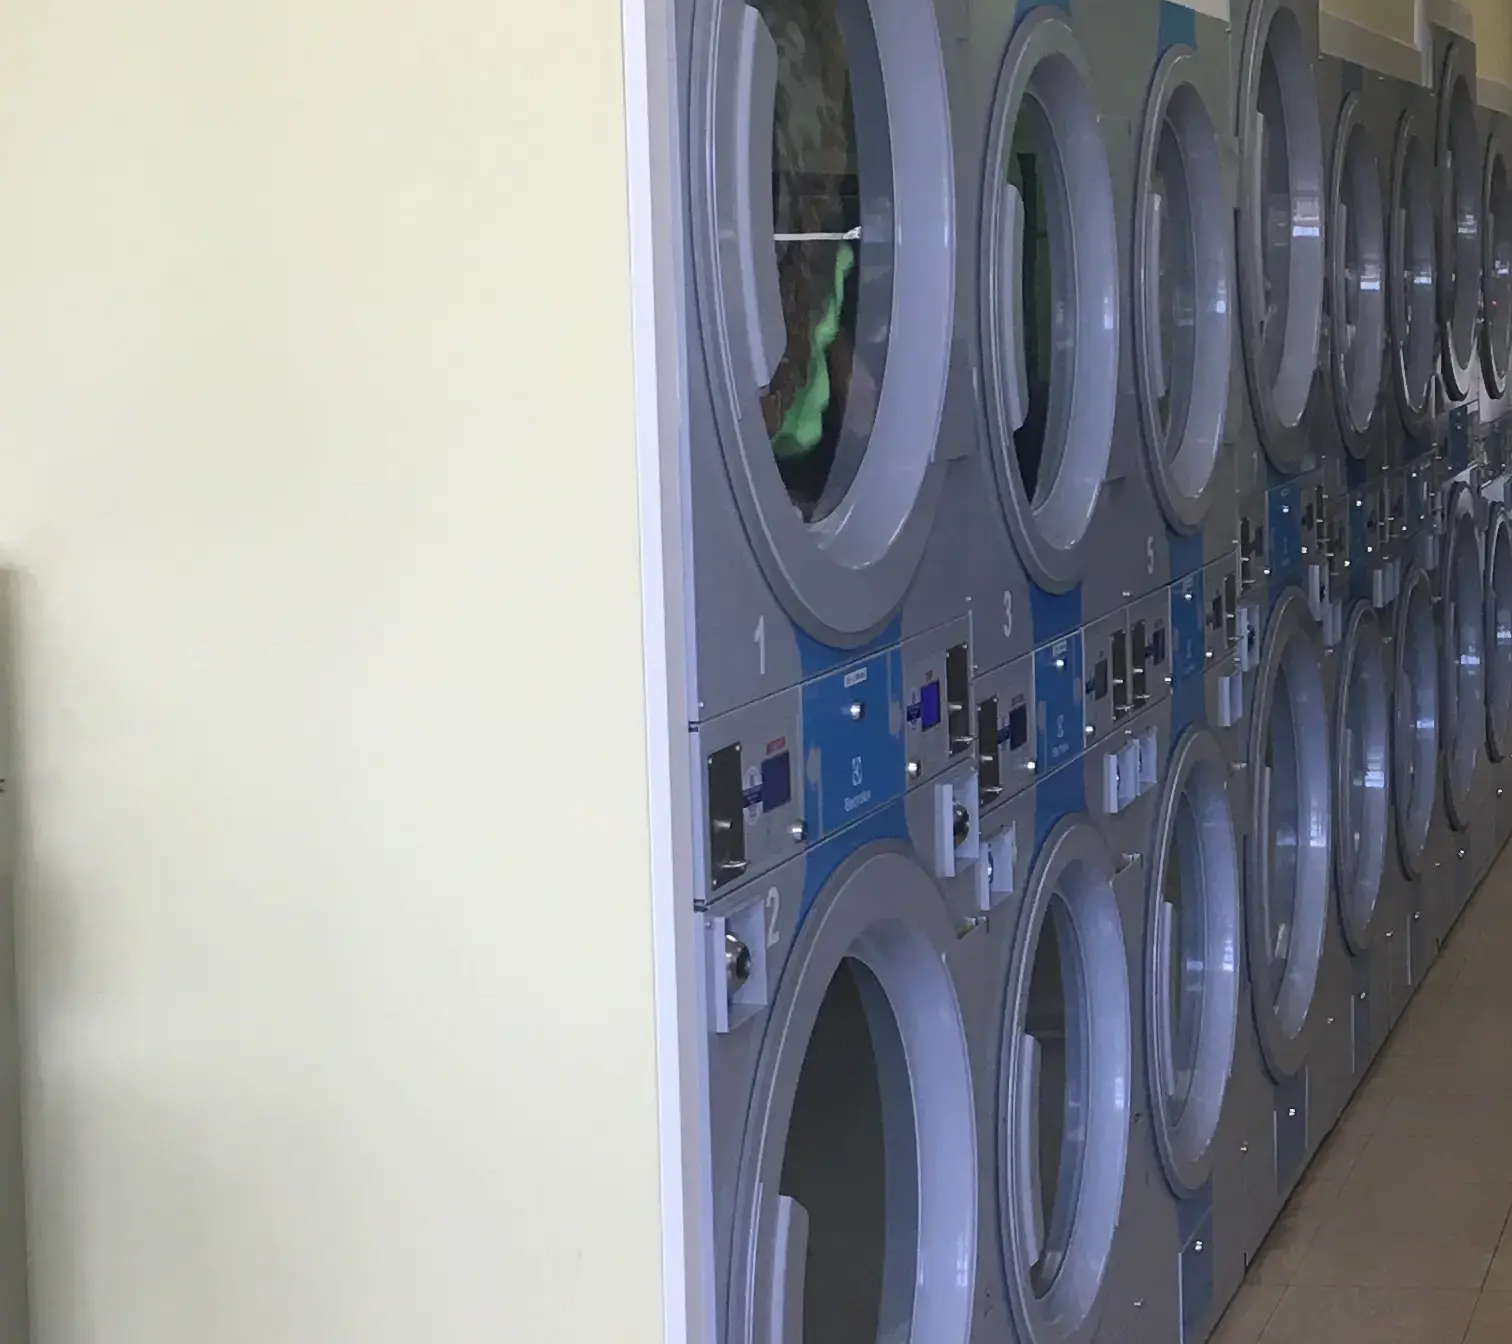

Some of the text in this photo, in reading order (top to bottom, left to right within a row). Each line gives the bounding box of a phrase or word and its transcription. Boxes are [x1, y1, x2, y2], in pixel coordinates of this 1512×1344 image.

[1145, 536, 1155, 574] 5
[1003, 590, 1013, 637] 3
[753, 615, 766, 676] 1
[765, 886, 780, 948] 2
